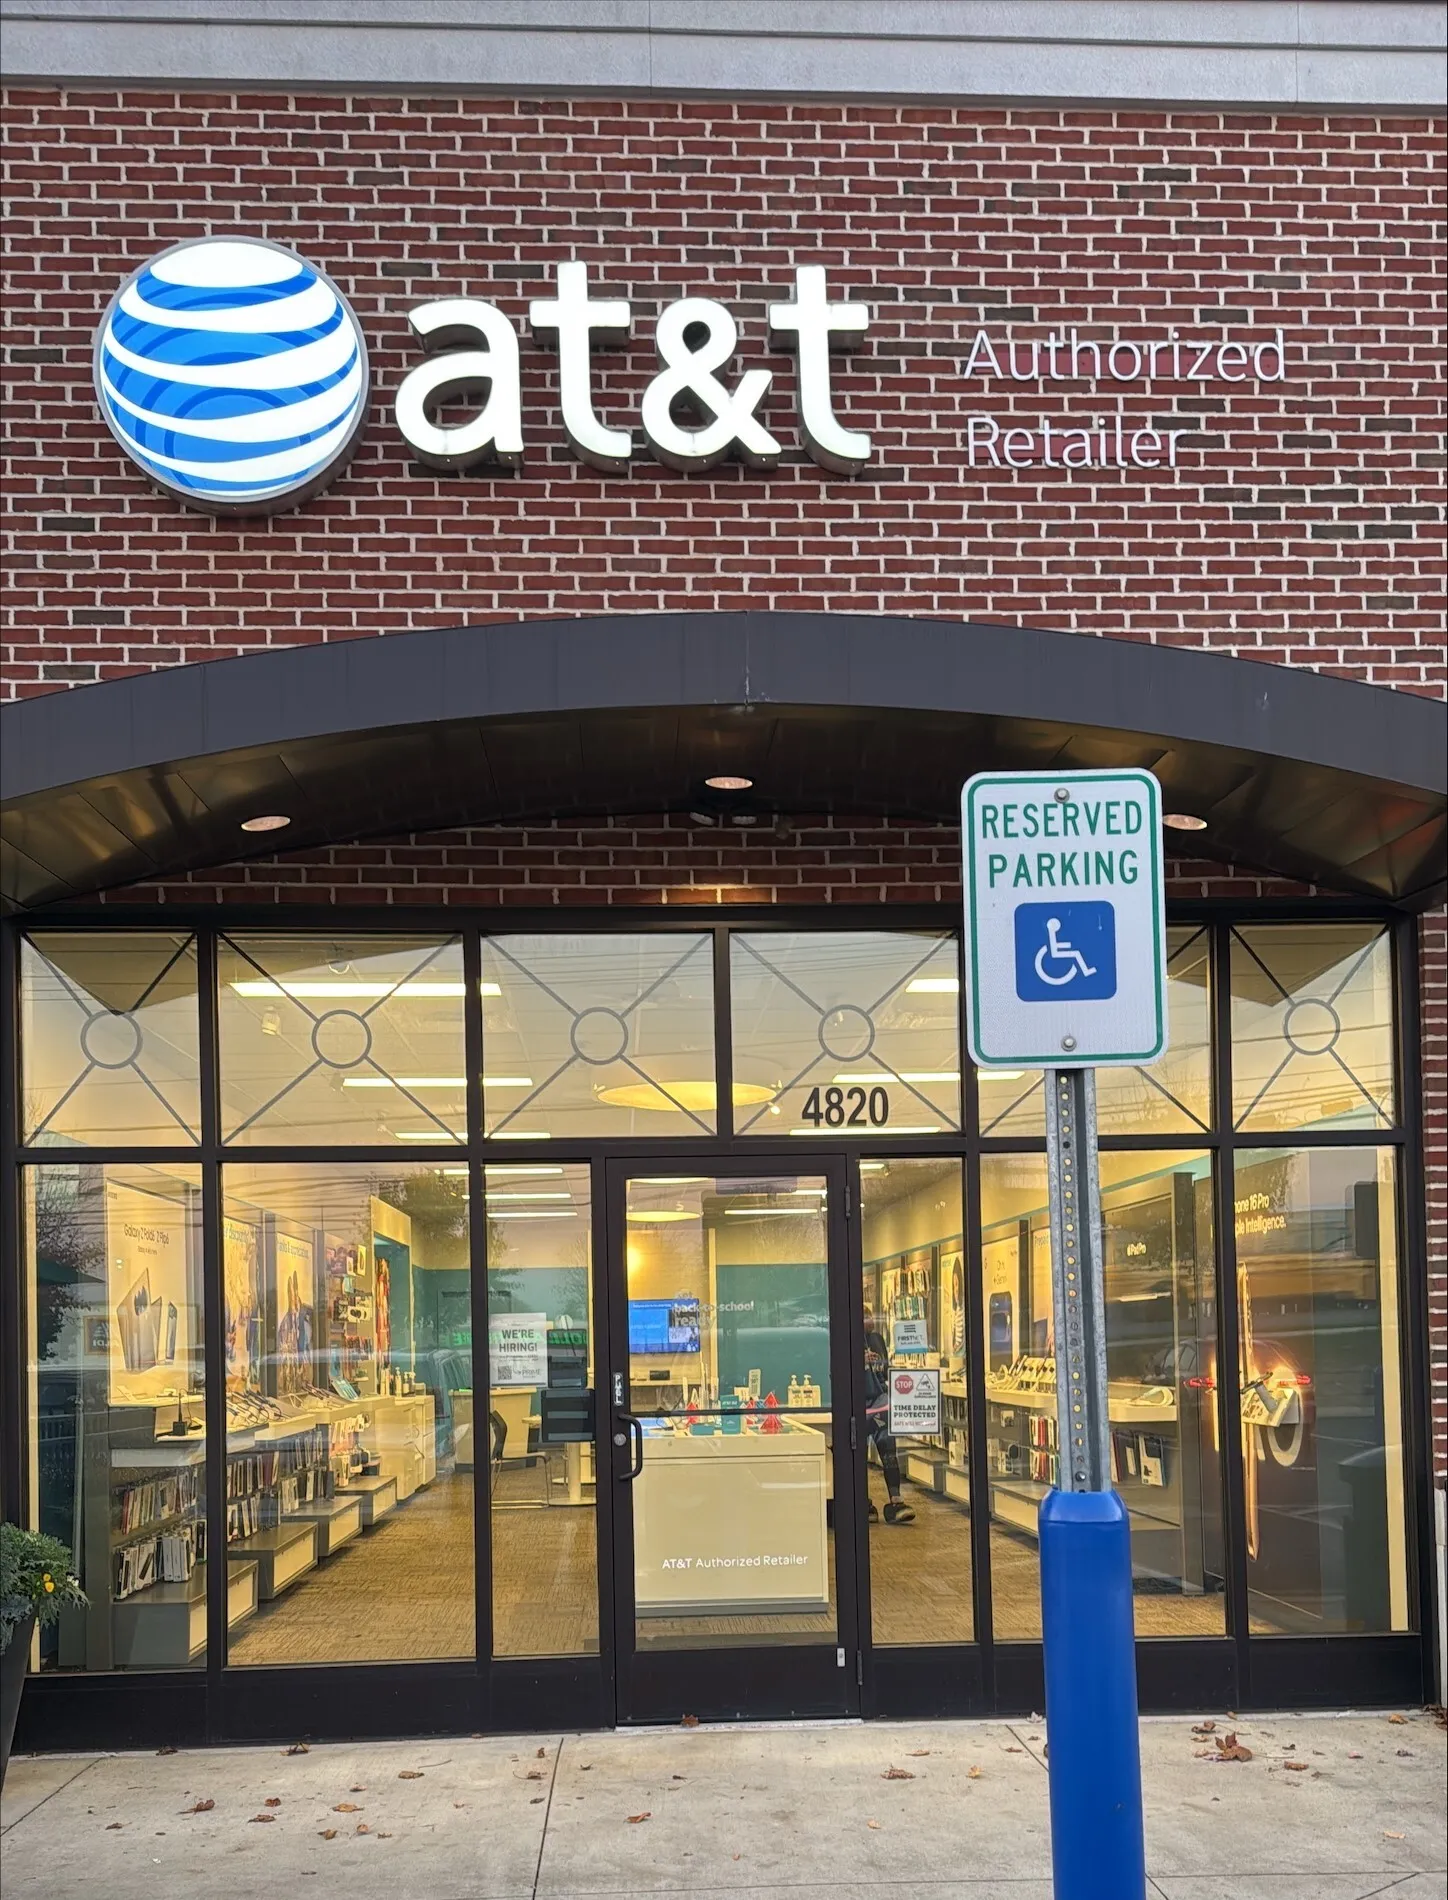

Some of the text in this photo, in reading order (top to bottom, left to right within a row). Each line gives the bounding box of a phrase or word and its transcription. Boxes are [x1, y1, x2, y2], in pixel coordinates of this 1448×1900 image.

[394, 261, 872, 466] at&t
[963, 328, 1286, 382] Authorized
[966, 415, 1187, 468] Retailer
[981, 800, 1142, 839] RESERVED
[988, 849, 1138, 888] PARKING
[801, 1086, 889, 1127] 4820
[1258, 1192, 1270, 1209] Pro
[499, 1342, 537, 1352] HIRING!
[501, 1329, 534, 1339] WE'RE
[895, 1380, 913, 1389] STOP
[662, 1553, 809, 1569] AT&T Authorized Retailer
